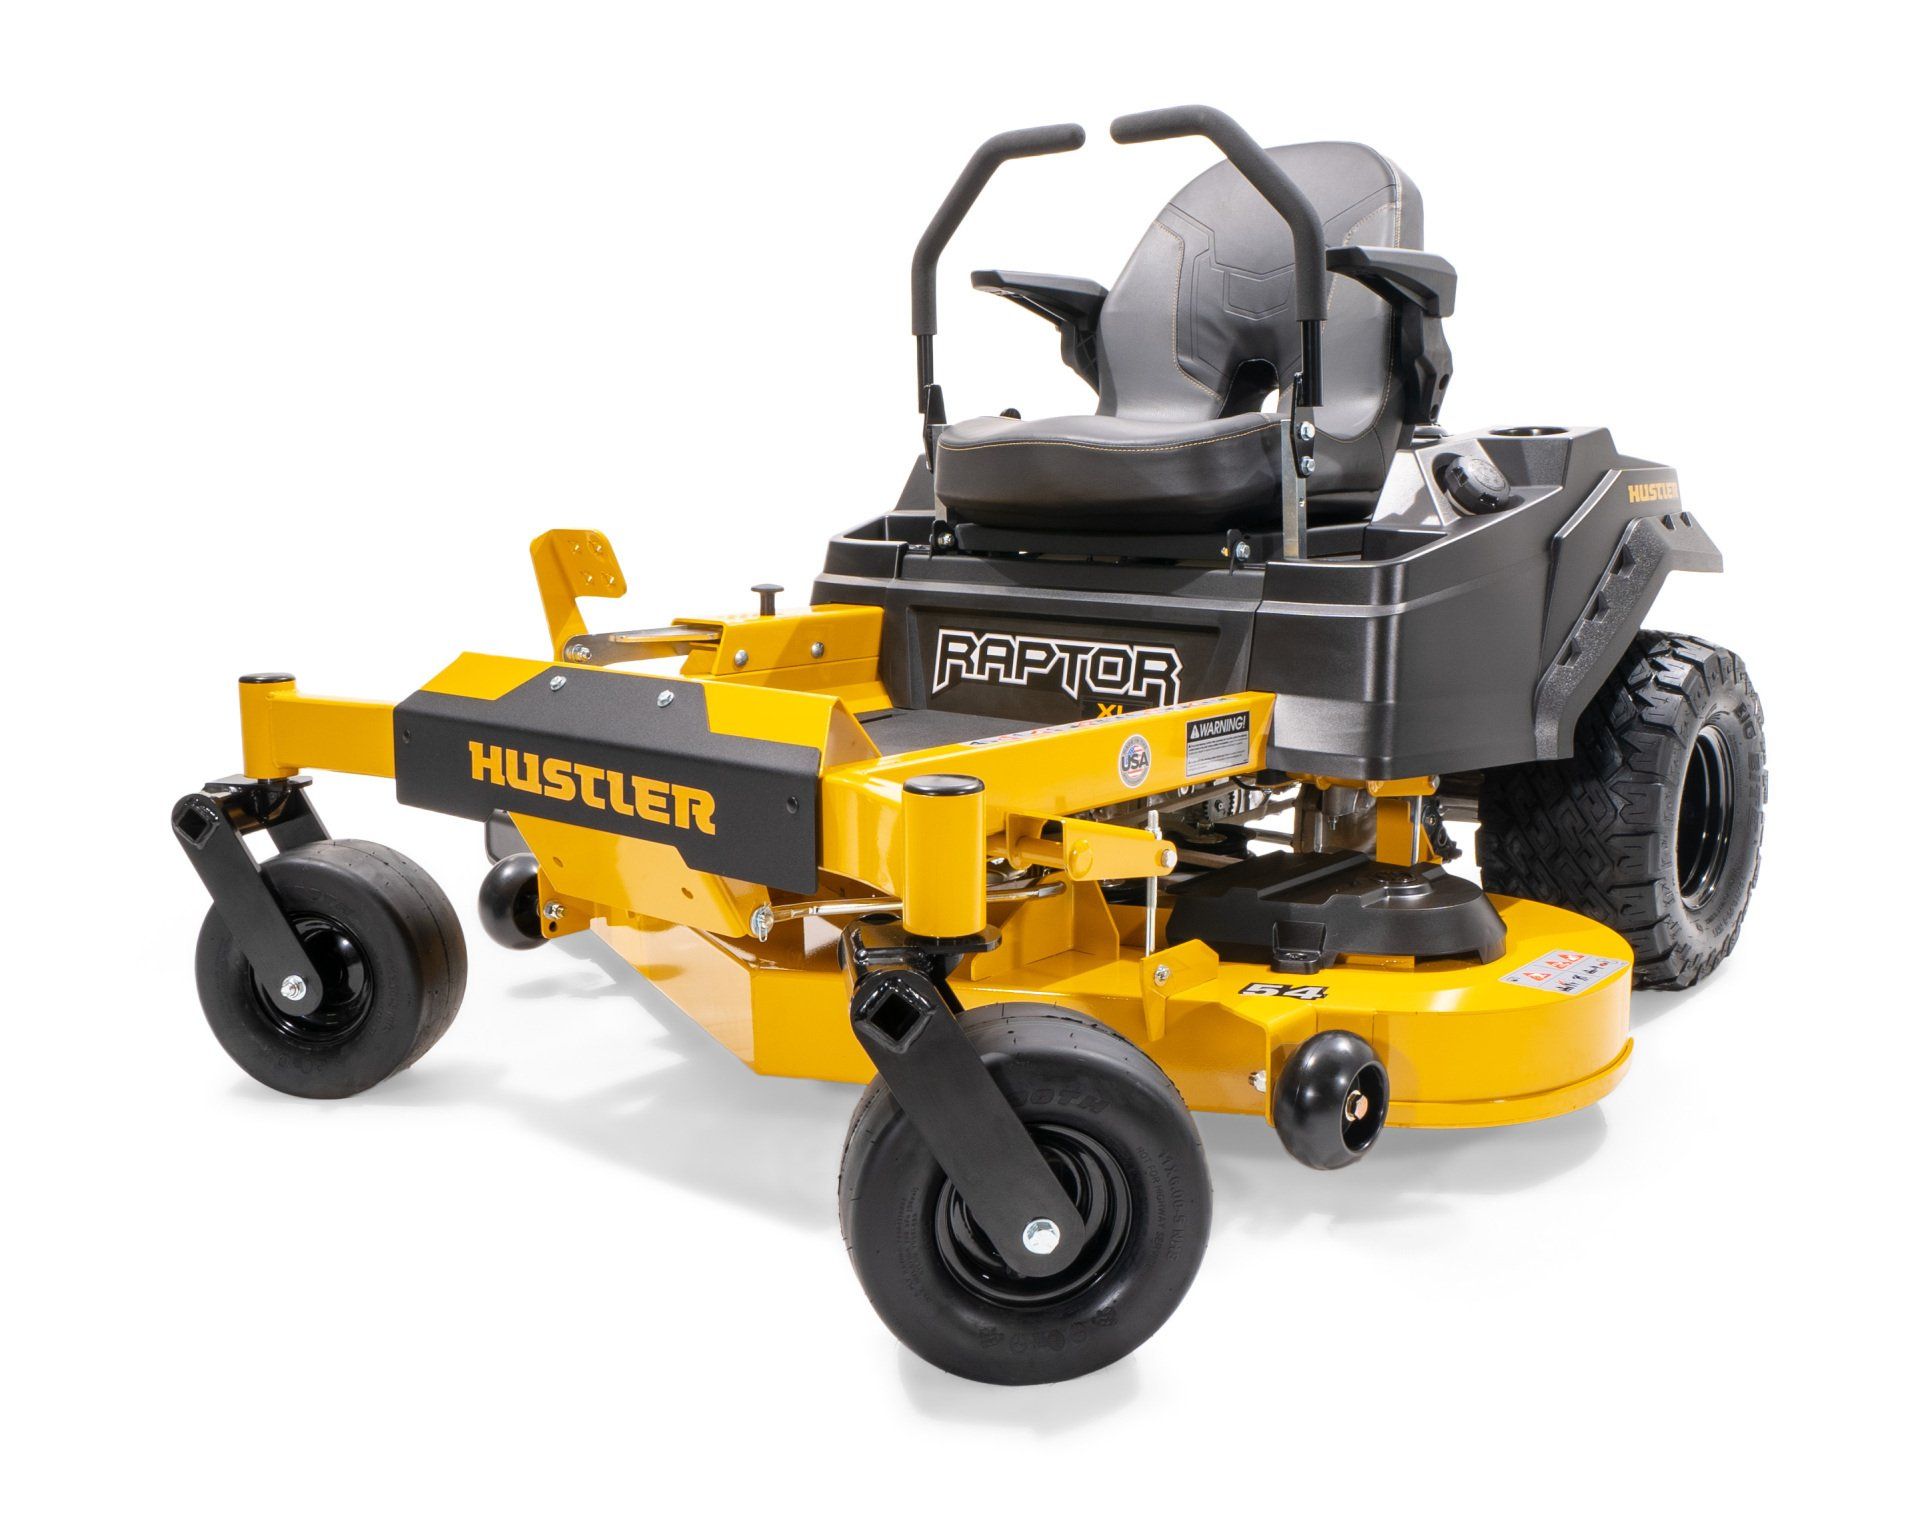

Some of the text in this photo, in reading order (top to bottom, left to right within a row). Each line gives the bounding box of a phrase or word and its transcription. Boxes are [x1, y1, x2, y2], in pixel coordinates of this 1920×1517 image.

[1627, 482, 1681, 503] HUSTLER
[932, 628, 1183, 708] RAPTOR
[1199, 715, 1247, 738] WARNING!
[1121, 751, 1149, 772] USA
[468, 741, 716, 836] HUSTLER
[1241, 983, 1324, 1000] 54
